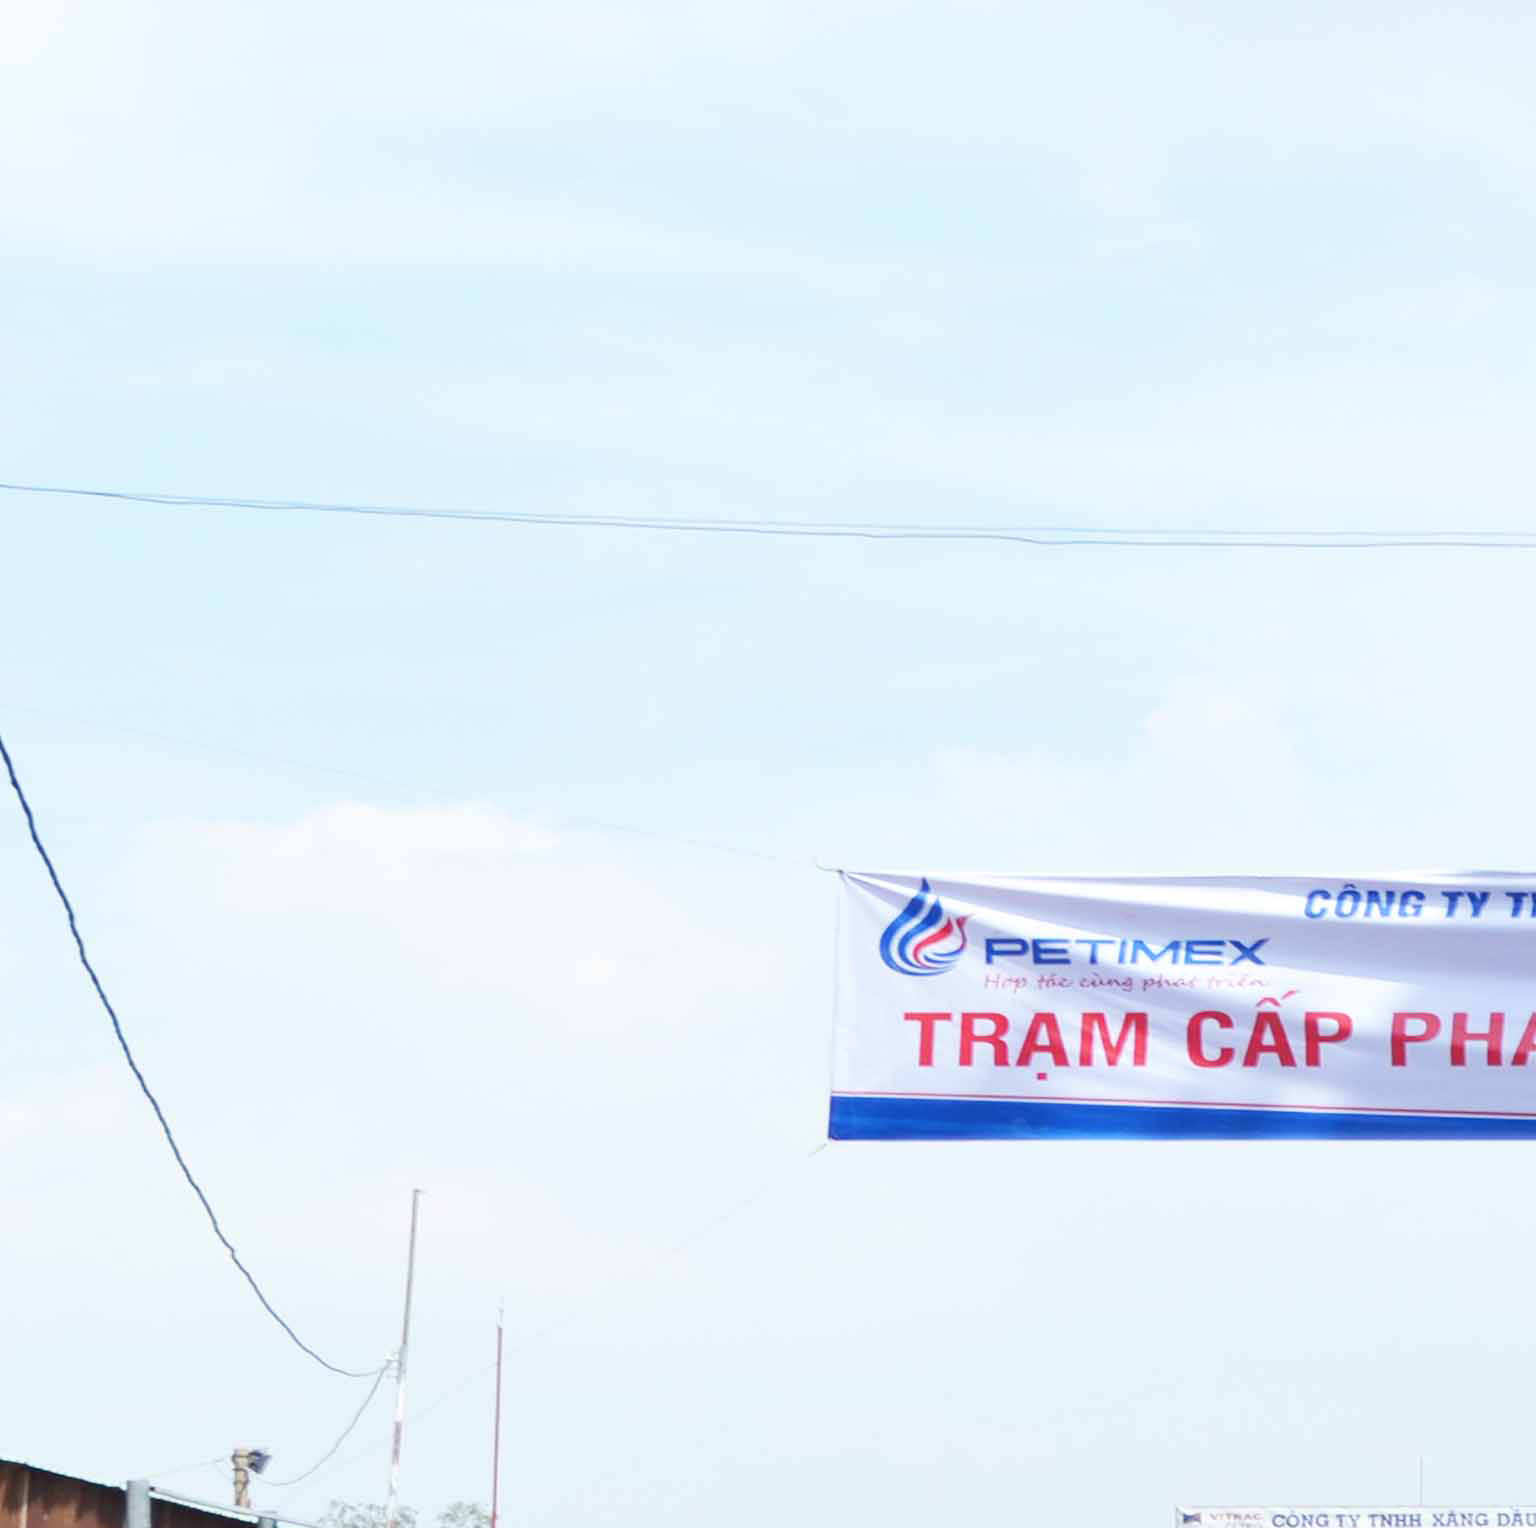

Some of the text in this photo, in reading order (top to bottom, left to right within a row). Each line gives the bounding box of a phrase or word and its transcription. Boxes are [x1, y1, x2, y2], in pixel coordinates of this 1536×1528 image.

[1303, 883, 1427, 920] CÔNG
[1440, 889, 1491, 919] TY
[983, 937, 1271, 966] PETIMEX
[903, 1010, 1149, 1081] TRẠM
[1186, 989, 1354, 1068] CẤP
[1271, 1510, 1329, 1528] CÔNG
[1336, 1514, 1361, 1528] TY
[1369, 1513, 1422, 1528] TNHH
